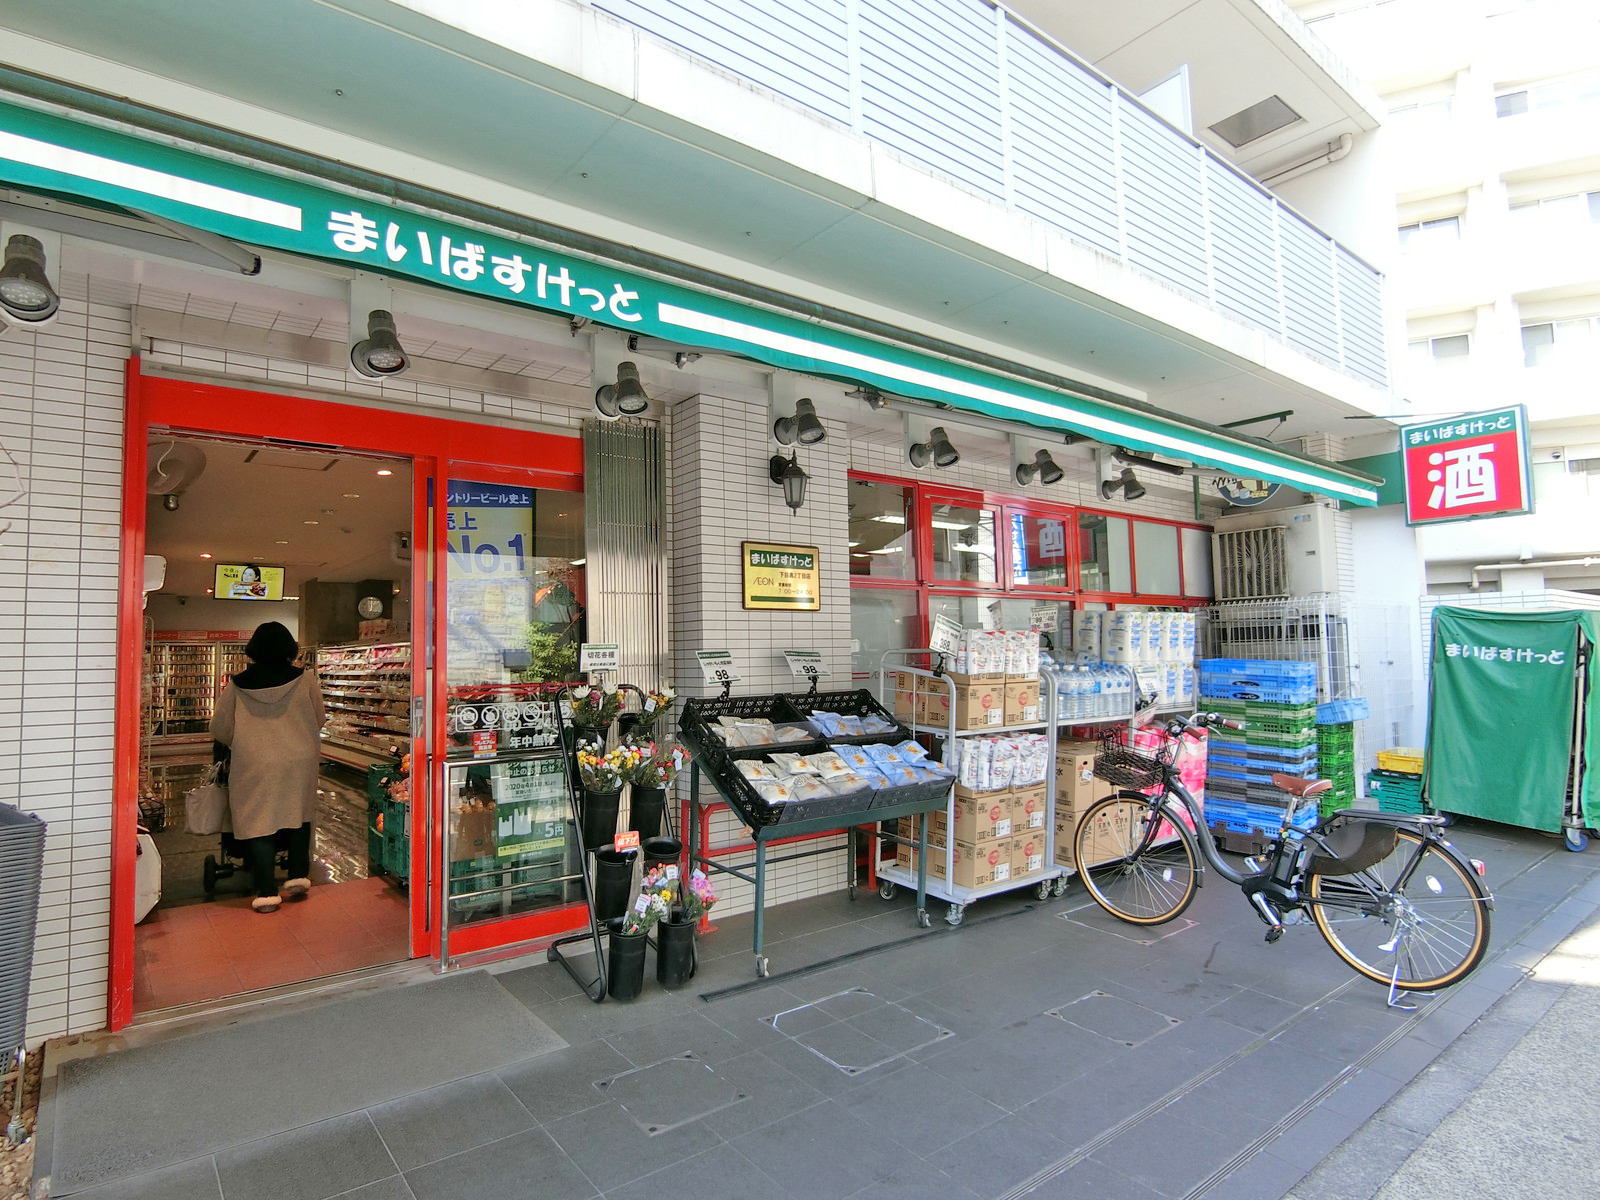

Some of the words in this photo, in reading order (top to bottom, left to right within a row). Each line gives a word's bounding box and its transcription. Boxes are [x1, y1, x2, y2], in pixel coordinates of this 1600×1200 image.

[327, 210, 643, 323] まいばすけっと
[1409, 416, 1512, 444] まいばすけっと
[1427, 443, 1497, 510] 酒
[750, 552, 813, 568] まいばすけっと
[587, 651, 615, 659] 切花各種
[1445, 643, 1565, 665] まいばすけっと
[714, 669, 729, 680] 98
[802, 665, 817, 674] 98
[509, 734, 556, 748] 年中無休
[545, 822, 564, 837] 5円
